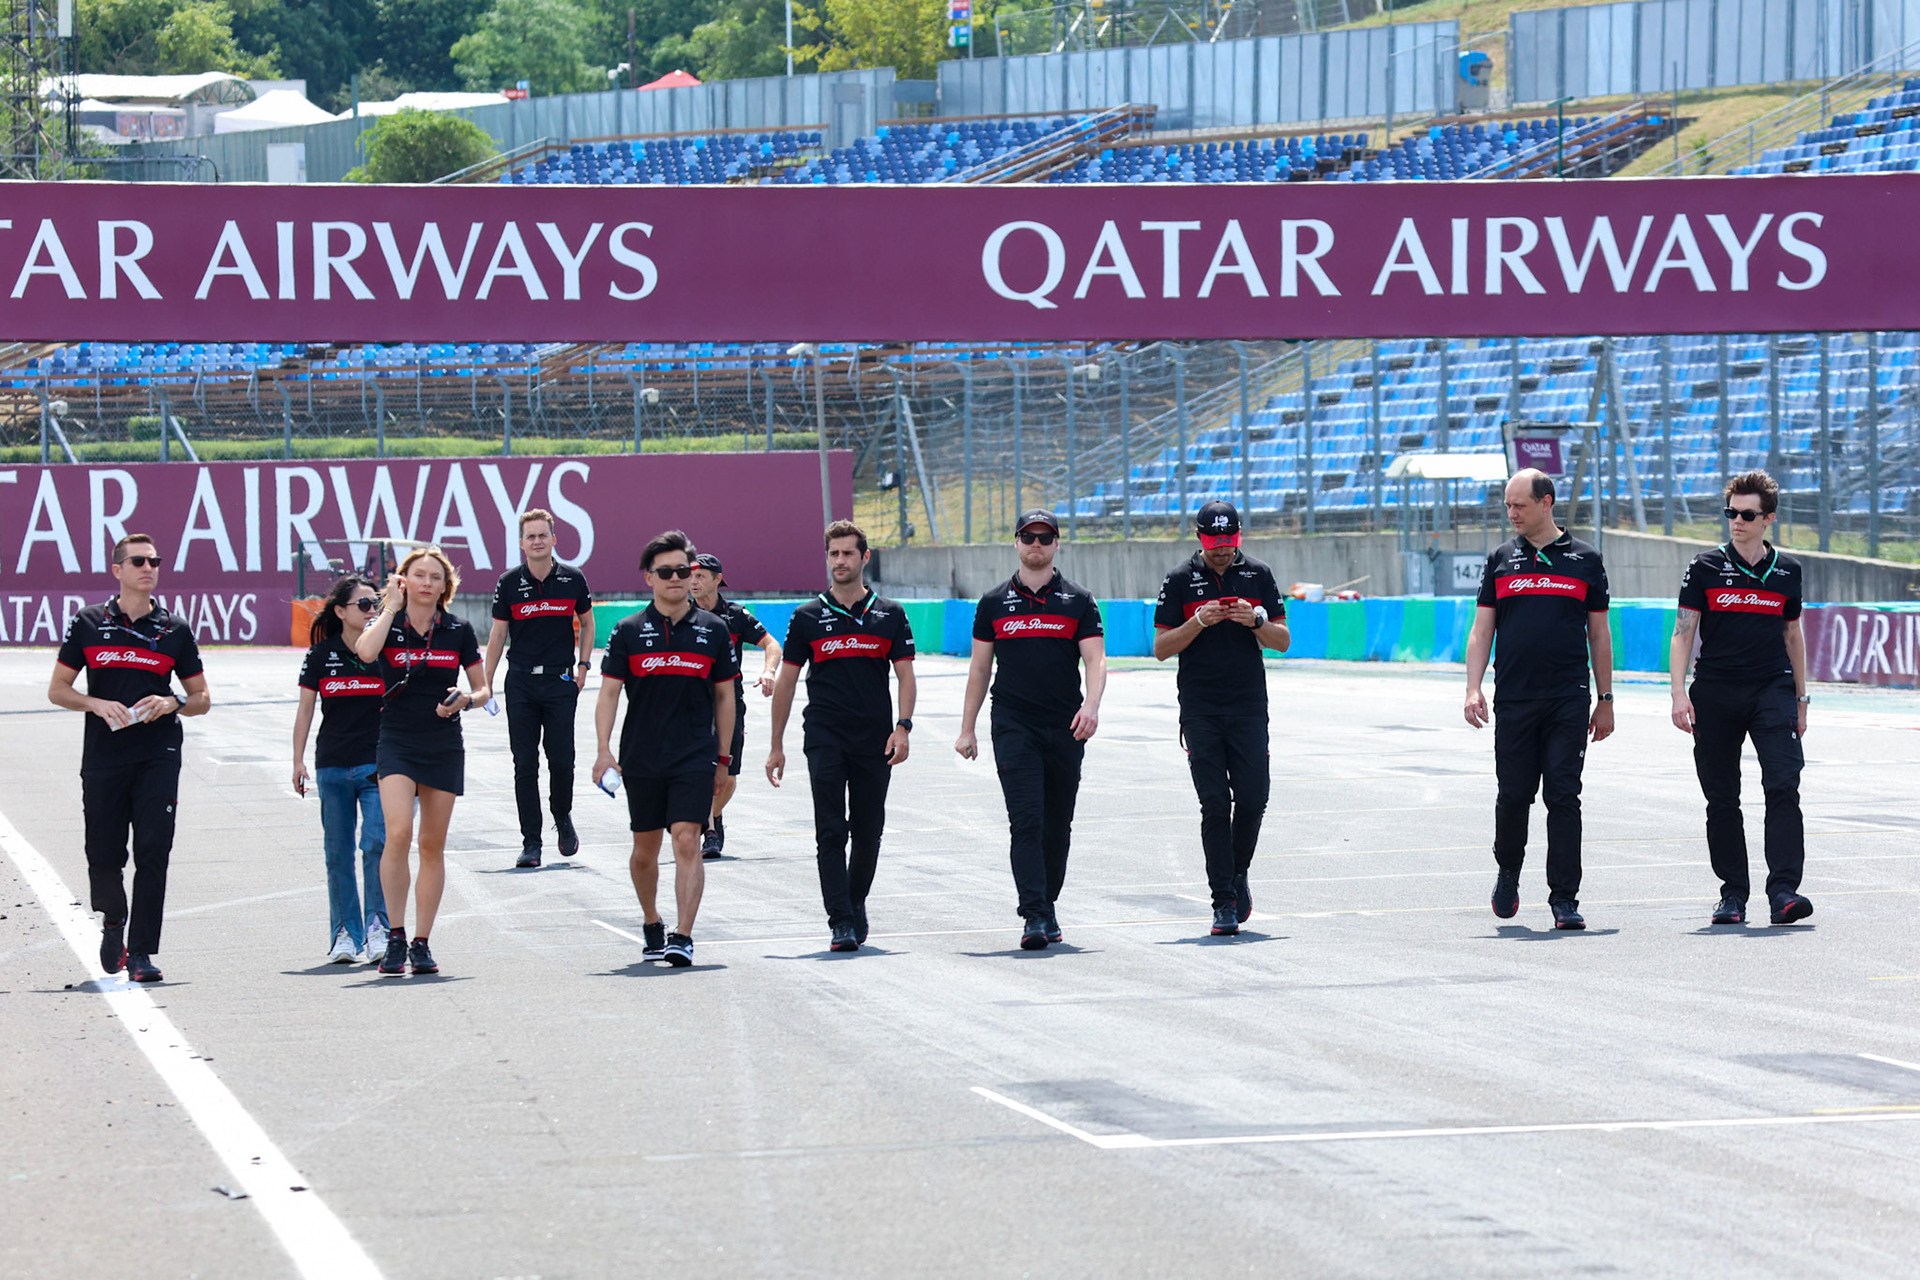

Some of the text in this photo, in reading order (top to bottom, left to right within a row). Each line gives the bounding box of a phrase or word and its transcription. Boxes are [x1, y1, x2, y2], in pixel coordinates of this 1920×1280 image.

[0, 218, 658, 301] AR AIRWAYS
[981, 211, 1827, 309] QATAR AIRWAYS
[1522, 442, 1551, 453] QATAR
[0, 461, 594, 574] AR AIRWAYS
[1509, 577, 1577, 592] Alfa Romeo
[1717, 594, 1780, 607] Alfa Romeo
[520, 602, 568, 616] Alfa Romeo
[1003, 618, 1065, 635] Alfa Romeo
[821, 637, 880, 654] Alfa Romeo
[96, 651, 159, 665] Alfa Romeo
[642, 655, 704, 672] Alfa Romeo
[325, 680, 380, 693] Alfa Romeo
